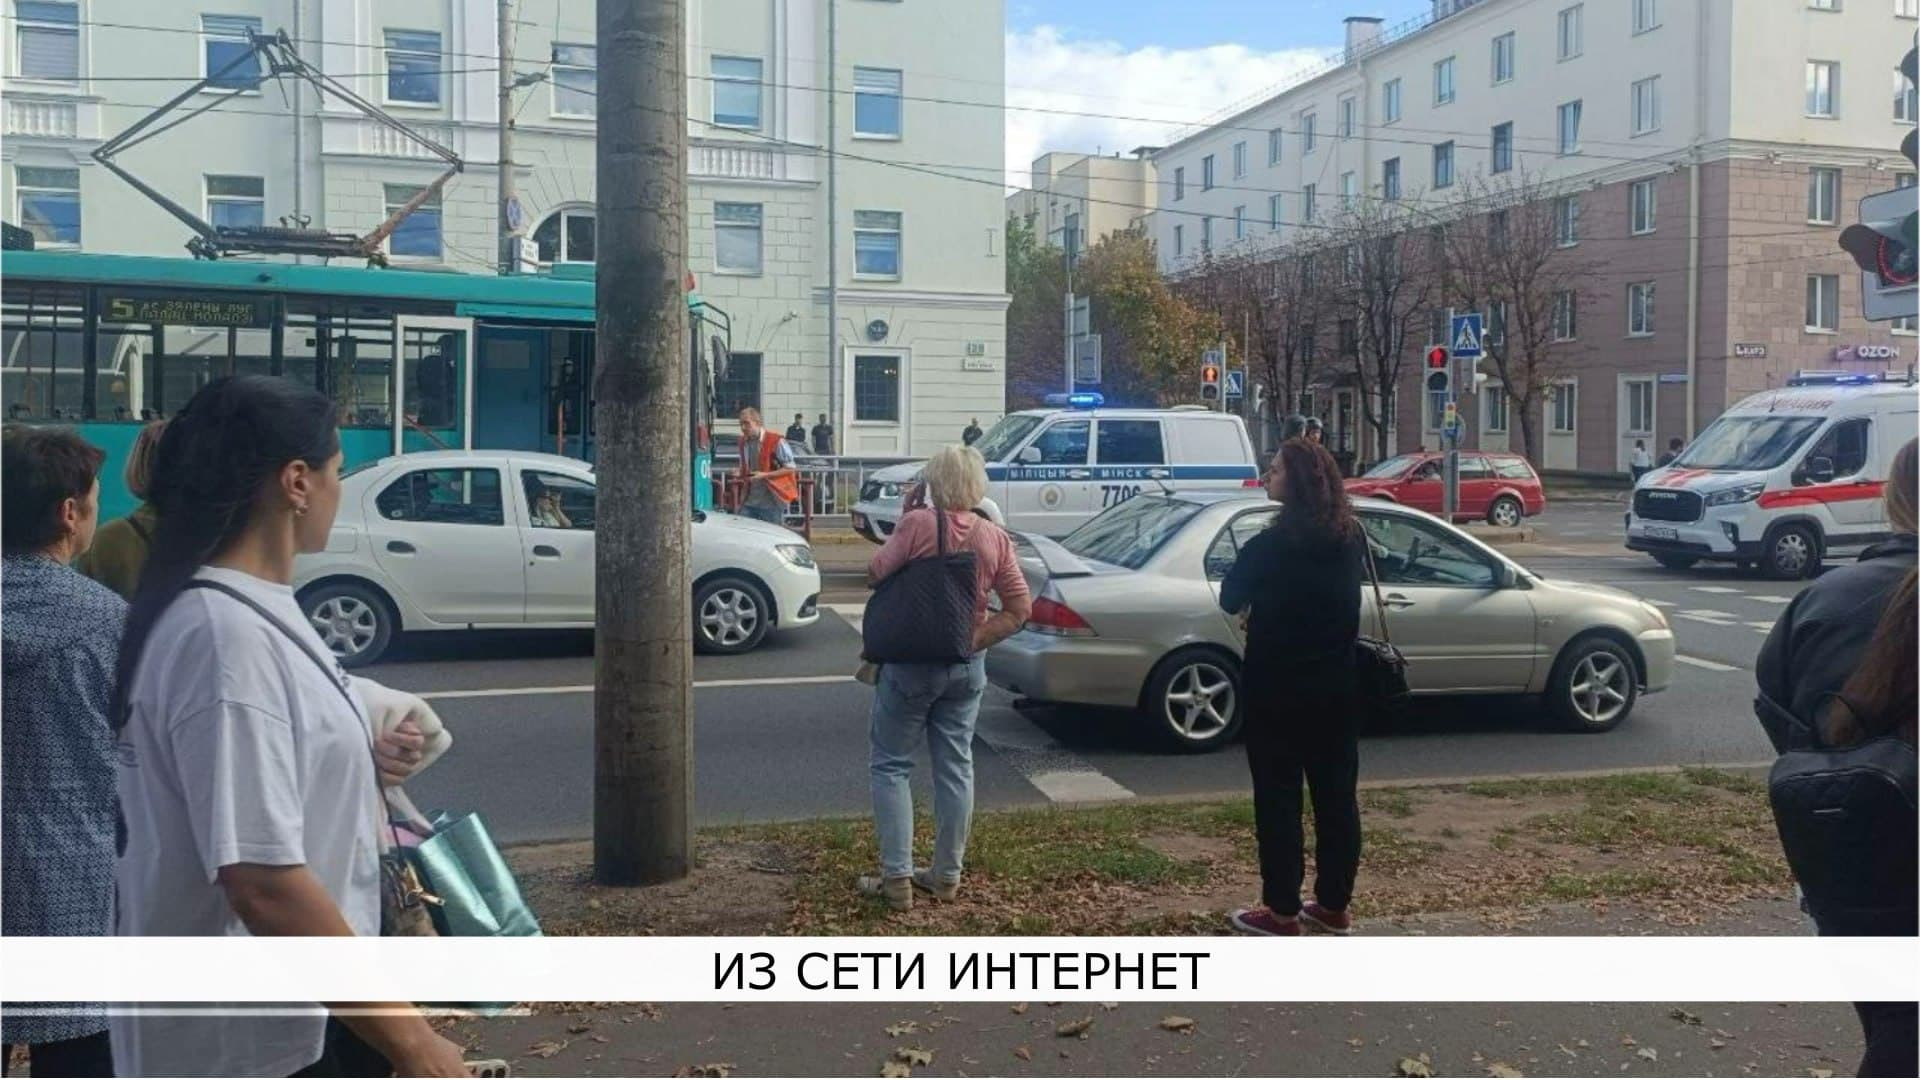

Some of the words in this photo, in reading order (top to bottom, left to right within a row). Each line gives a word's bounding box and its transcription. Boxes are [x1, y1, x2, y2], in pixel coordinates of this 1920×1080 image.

[112, 298, 134, 318] 5
[1858, 346, 1900, 358] OZON
[1101, 468, 1143, 478] МІНСК
